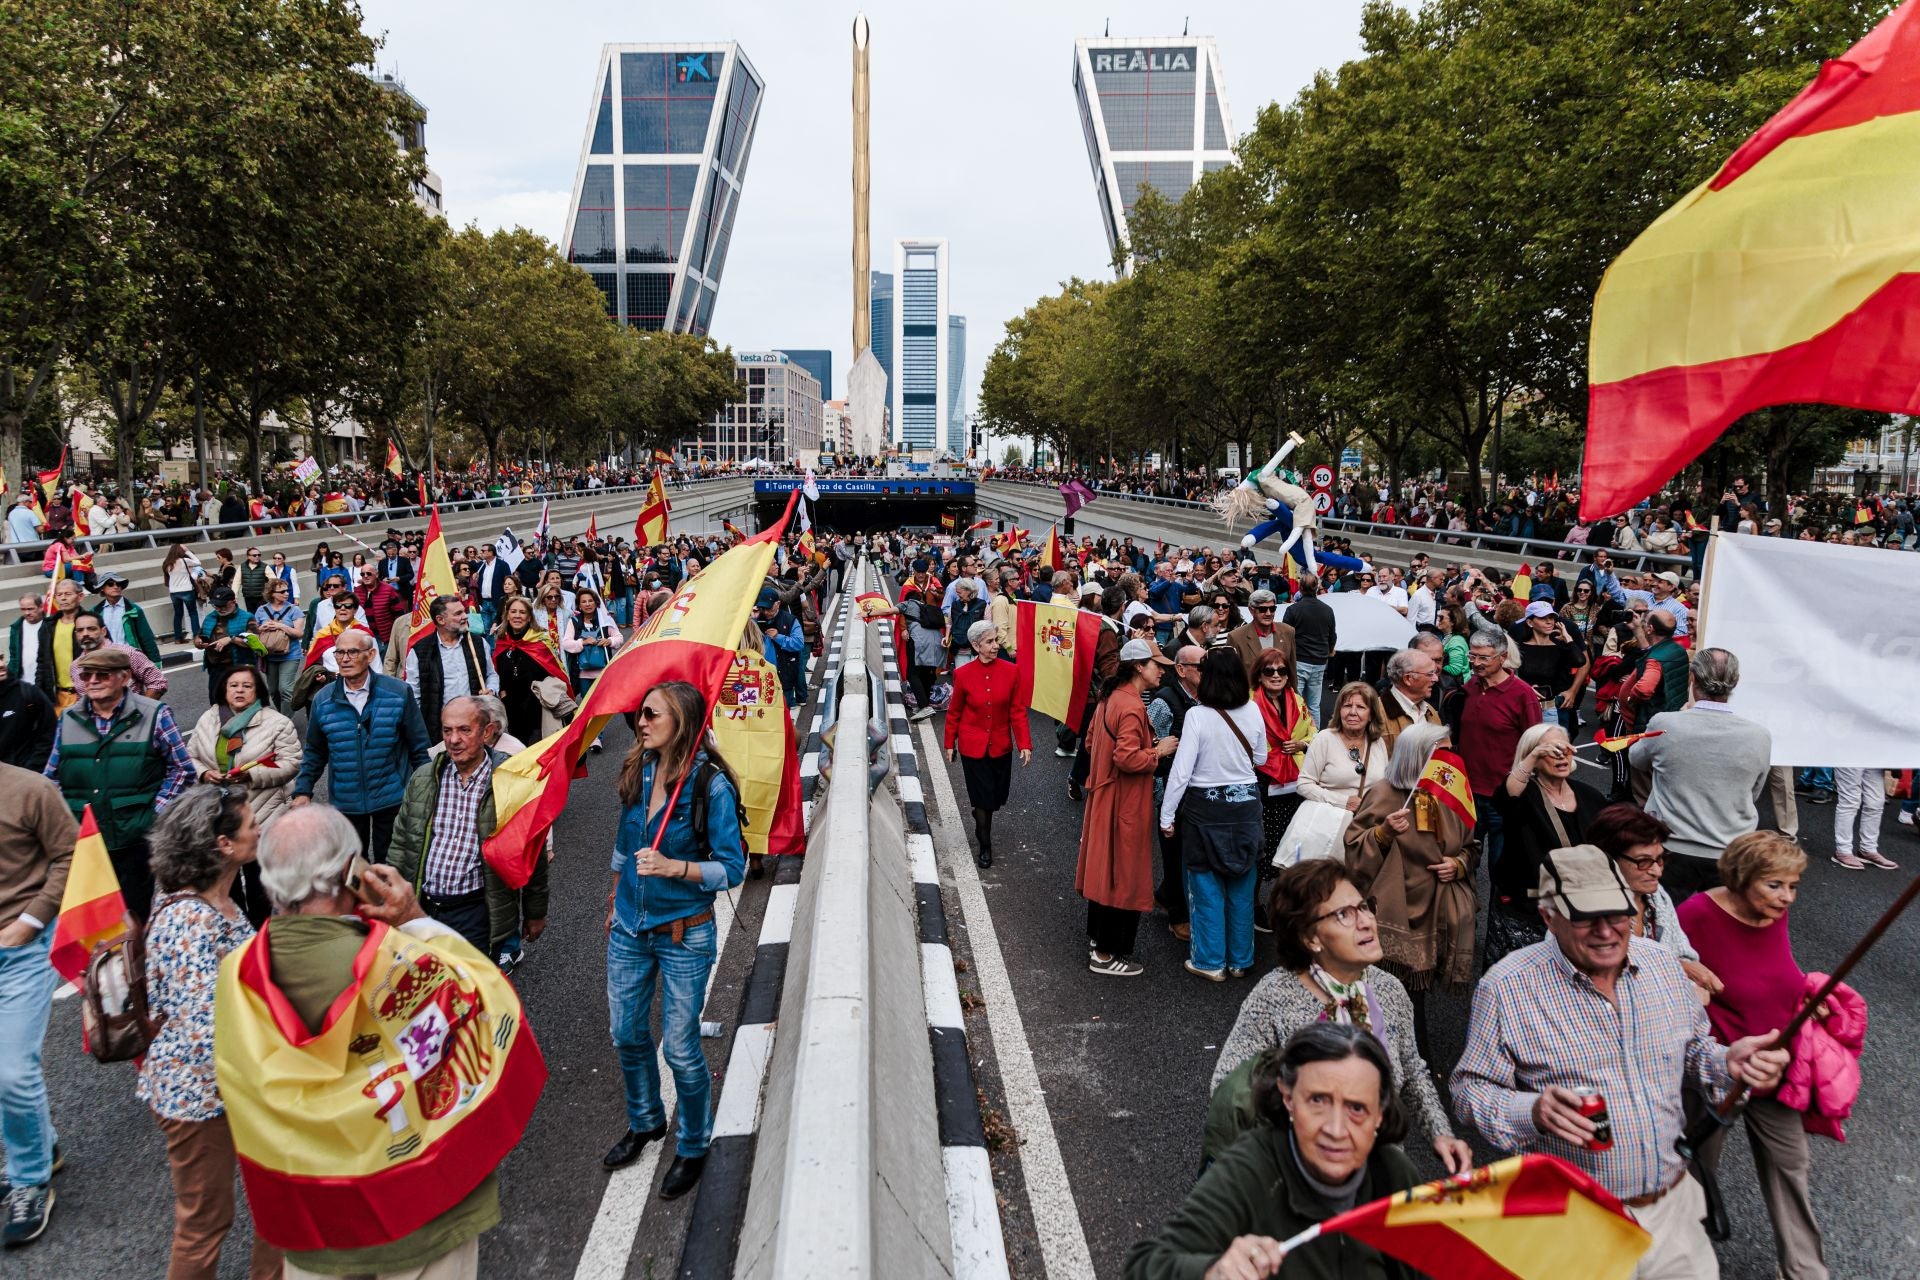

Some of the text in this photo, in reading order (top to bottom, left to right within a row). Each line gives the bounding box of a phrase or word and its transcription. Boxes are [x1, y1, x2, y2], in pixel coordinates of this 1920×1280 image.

[740, 354, 762, 362] testa
[1316, 474, 1329, 482] 50
[773, 482, 794, 490] Túnel
